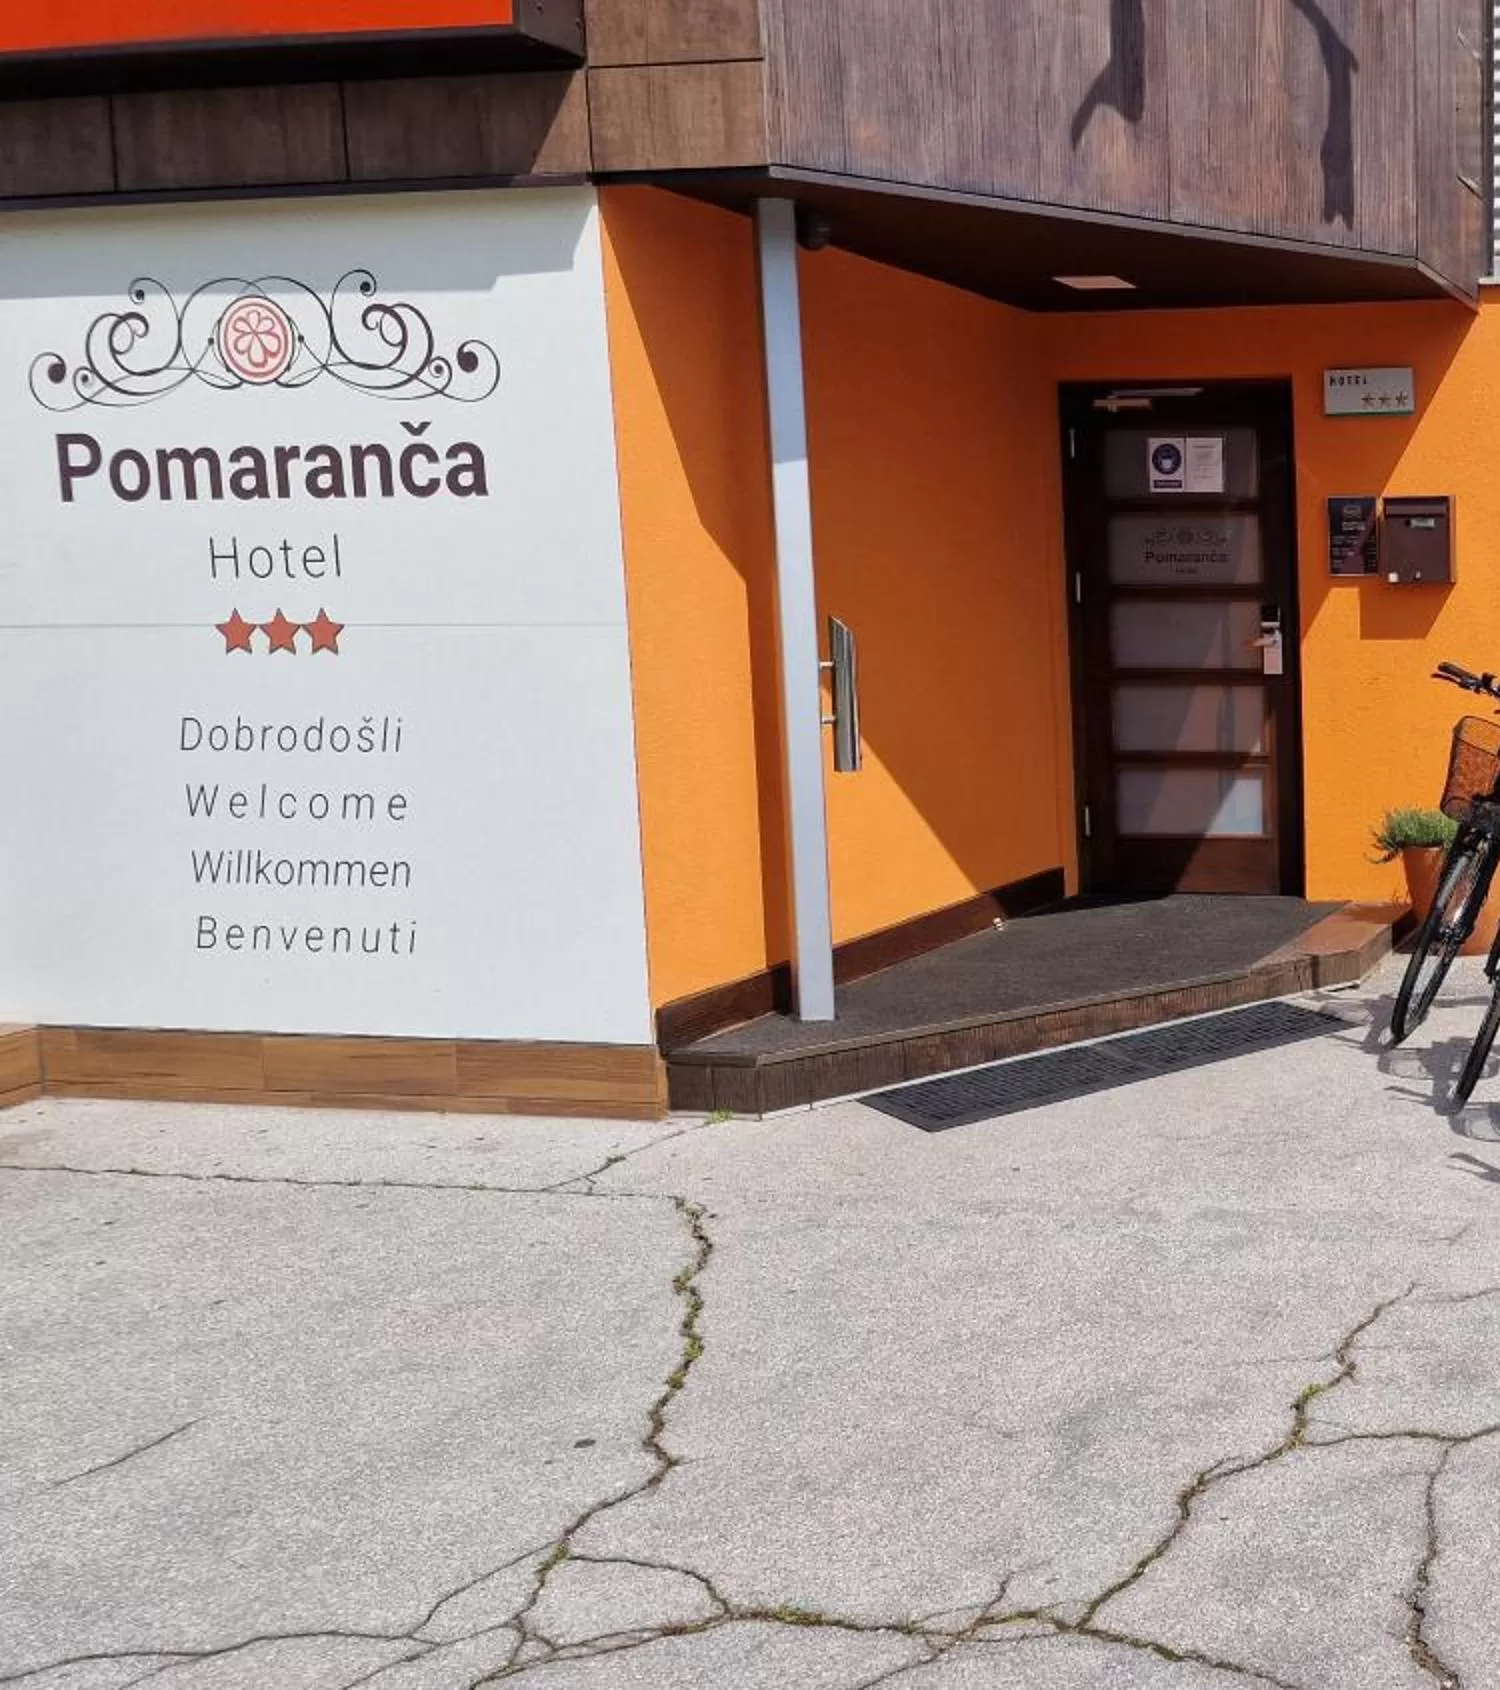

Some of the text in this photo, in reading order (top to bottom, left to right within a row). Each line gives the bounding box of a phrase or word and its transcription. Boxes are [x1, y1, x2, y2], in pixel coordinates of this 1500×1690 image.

[55, 421, 489, 503] Pomaranča
[209, 533, 342, 580] Hotel
[179, 714, 403, 754] Dobrodošli
[185, 783, 408, 822] Welcome
[191, 849, 412, 889] Willkommen
[196, 915, 417, 956] Benvenuti
